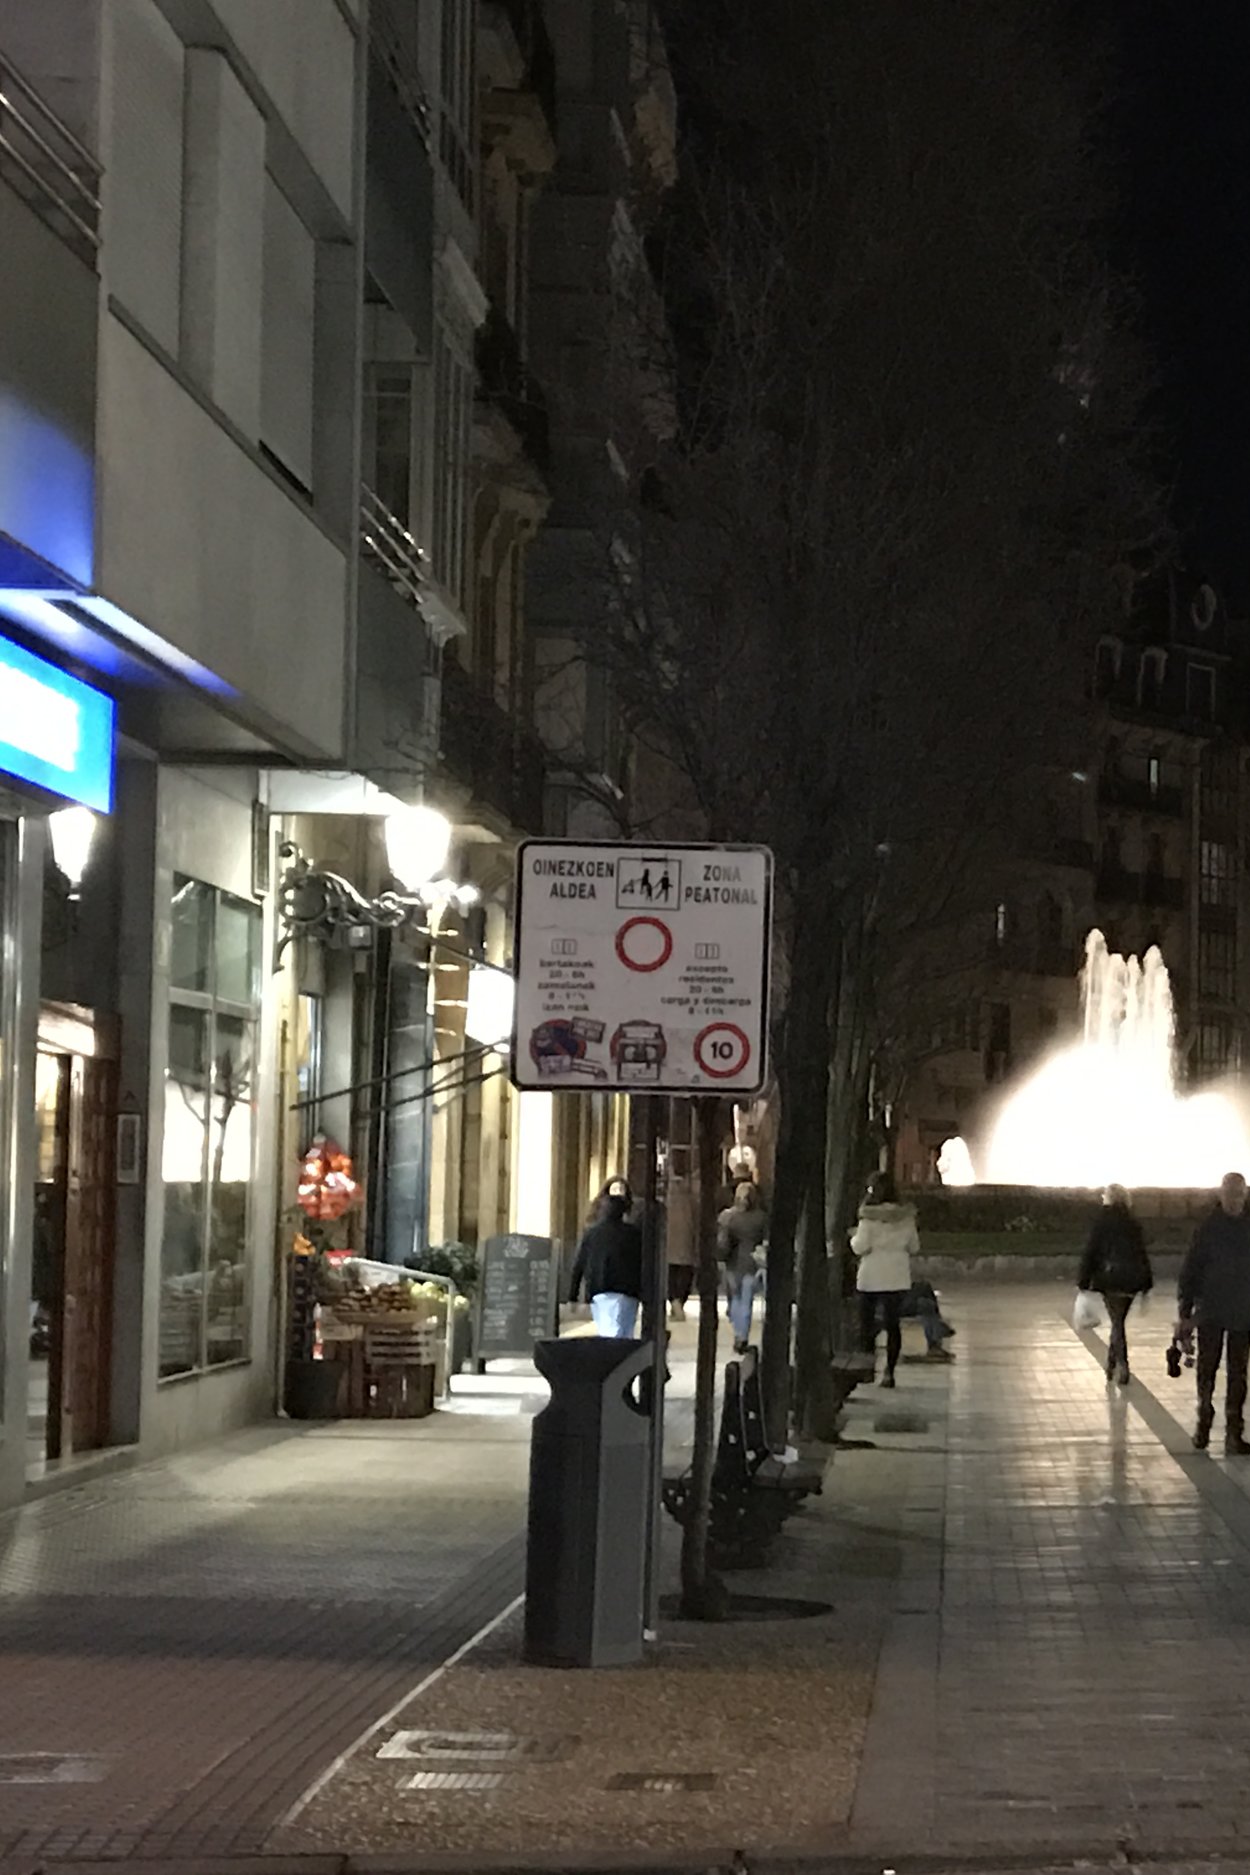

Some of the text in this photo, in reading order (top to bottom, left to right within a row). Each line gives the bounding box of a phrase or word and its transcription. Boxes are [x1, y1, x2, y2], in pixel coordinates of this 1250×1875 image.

[533, 858, 615, 878] OINEZKOEN
[703, 864, 742, 882] ZONA
[549, 881, 597, 899] ALDEA
[685, 885, 758, 905] PEATONAL
[711, 1041, 734, 1060] 10
